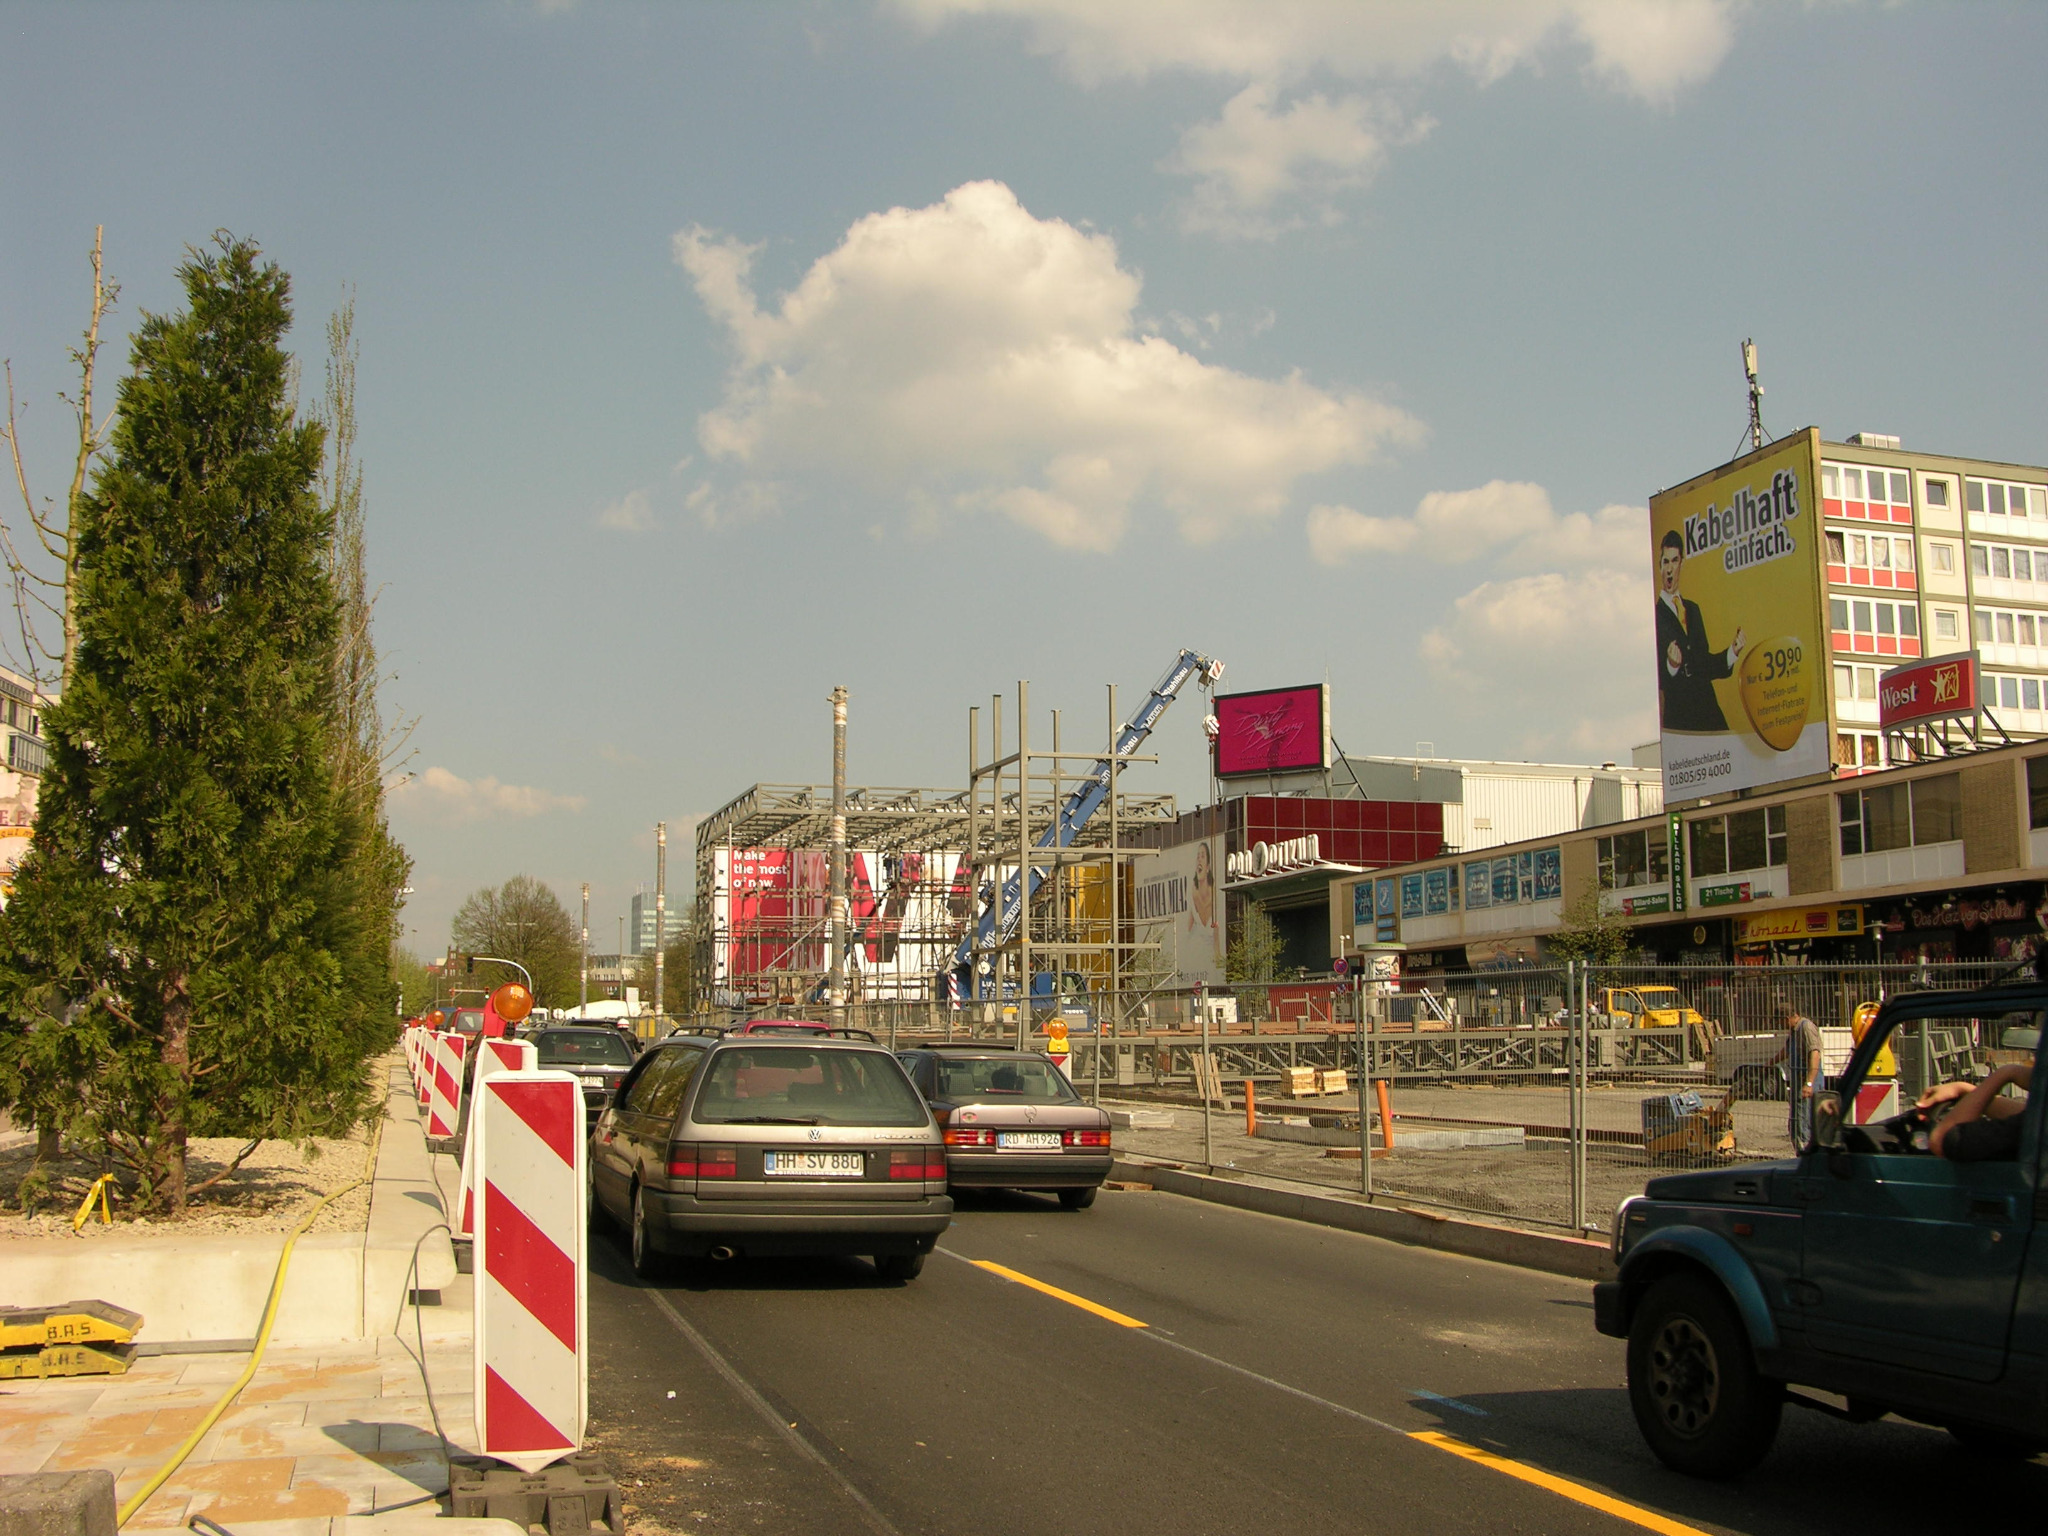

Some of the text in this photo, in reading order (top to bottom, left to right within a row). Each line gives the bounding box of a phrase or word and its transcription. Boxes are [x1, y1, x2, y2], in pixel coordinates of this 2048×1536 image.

[1685, 472, 1796, 555] Kabelhaft
[1725, 524, 1791, 570] einfach.
[1161, 667, 1188, 696] Stahlbau
[1881, 681, 1918, 710] West
[1234, 705, 1288, 735] Dirty
[1118, 735, 1138, 756] hlbau
[1242, 721, 1304, 753] Dancing
[1669, 749, 1731, 771] kabeldeutschland.de
[1708, 763, 1732, 778] 4000
[1673, 823, 1681, 871] BILLARD
[733, 863, 787, 874] the most
[1539, 853, 1560, 870] Sex
[1136, 876, 1188, 919] MAMMA MIA!
[1005, 1133, 1060, 1144] RD AH 926
[775, 1153, 860, 1169] HH SV 880
[47, 1322, 96, 1339] B.A.S.
